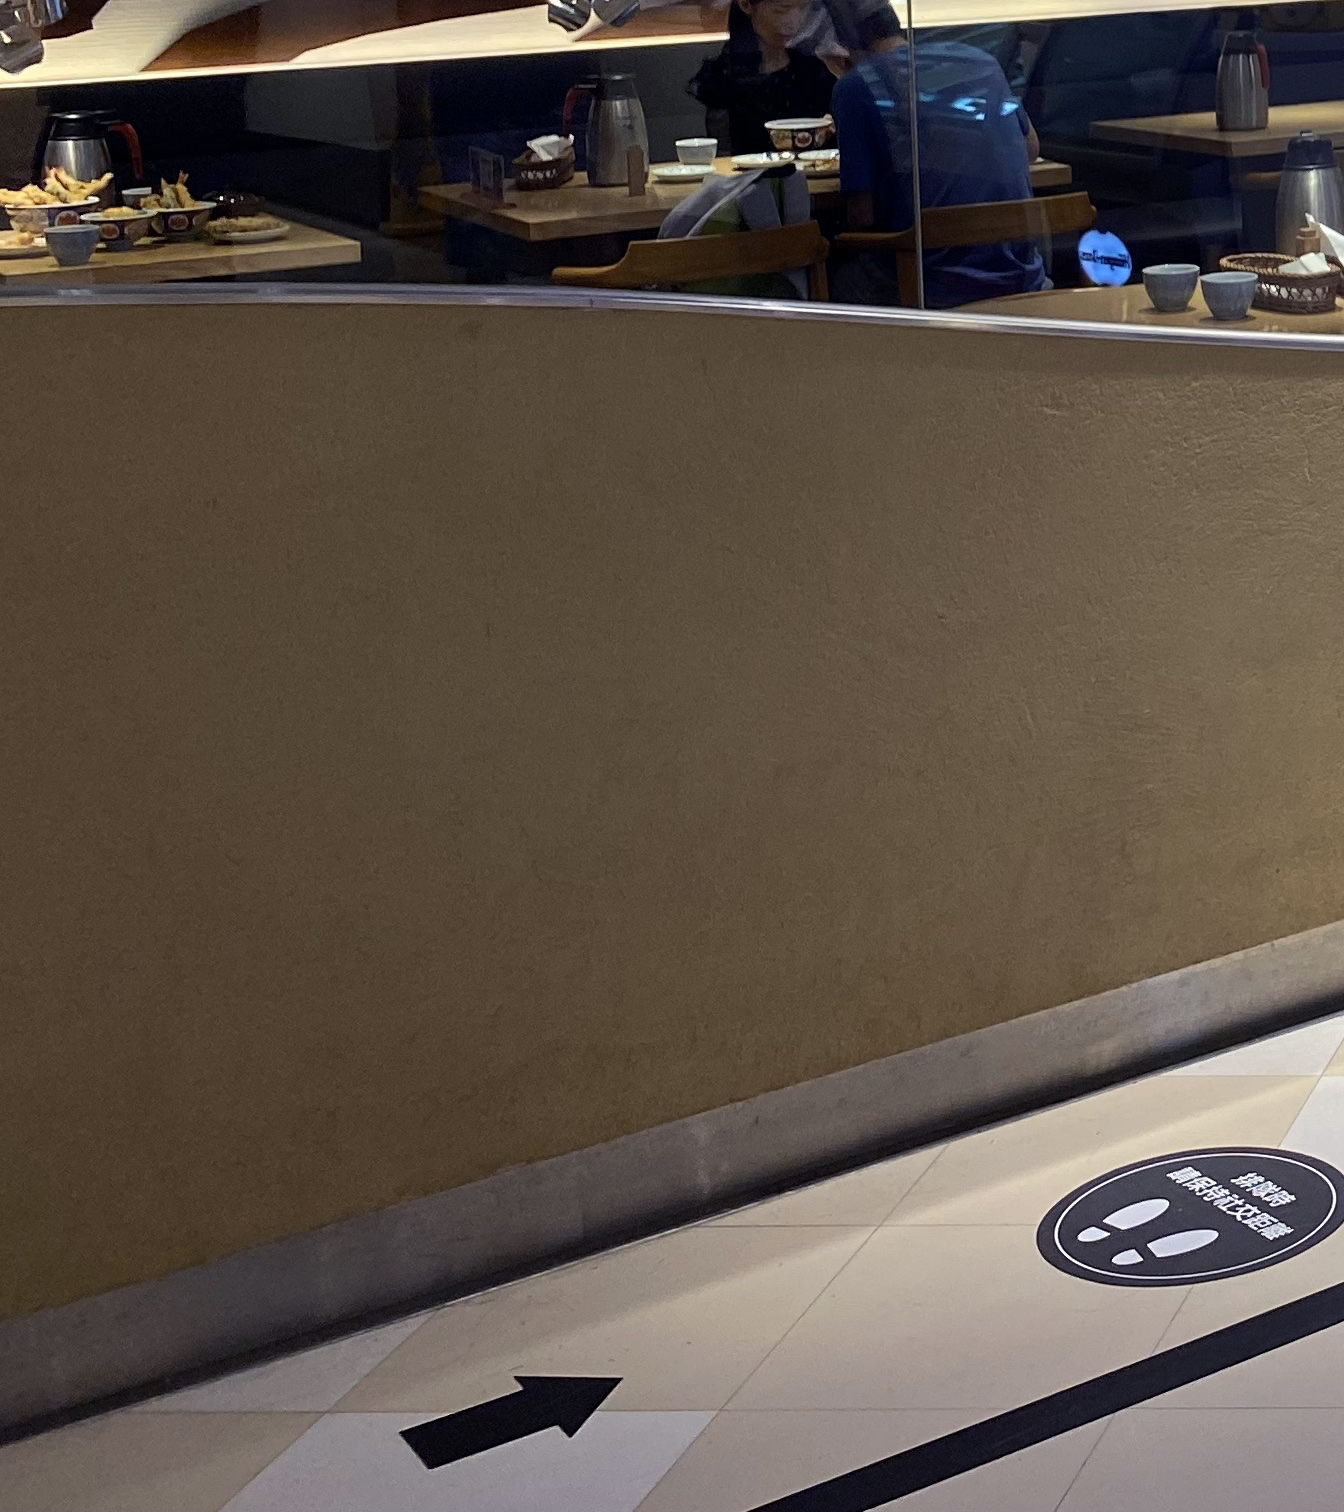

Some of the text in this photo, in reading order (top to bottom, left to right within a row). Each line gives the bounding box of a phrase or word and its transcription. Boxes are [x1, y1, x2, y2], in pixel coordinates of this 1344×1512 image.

[1165, 1166, 1295, 1241] 請保持社交距離
[1230, 1172, 1297, 1207] 排隊時
